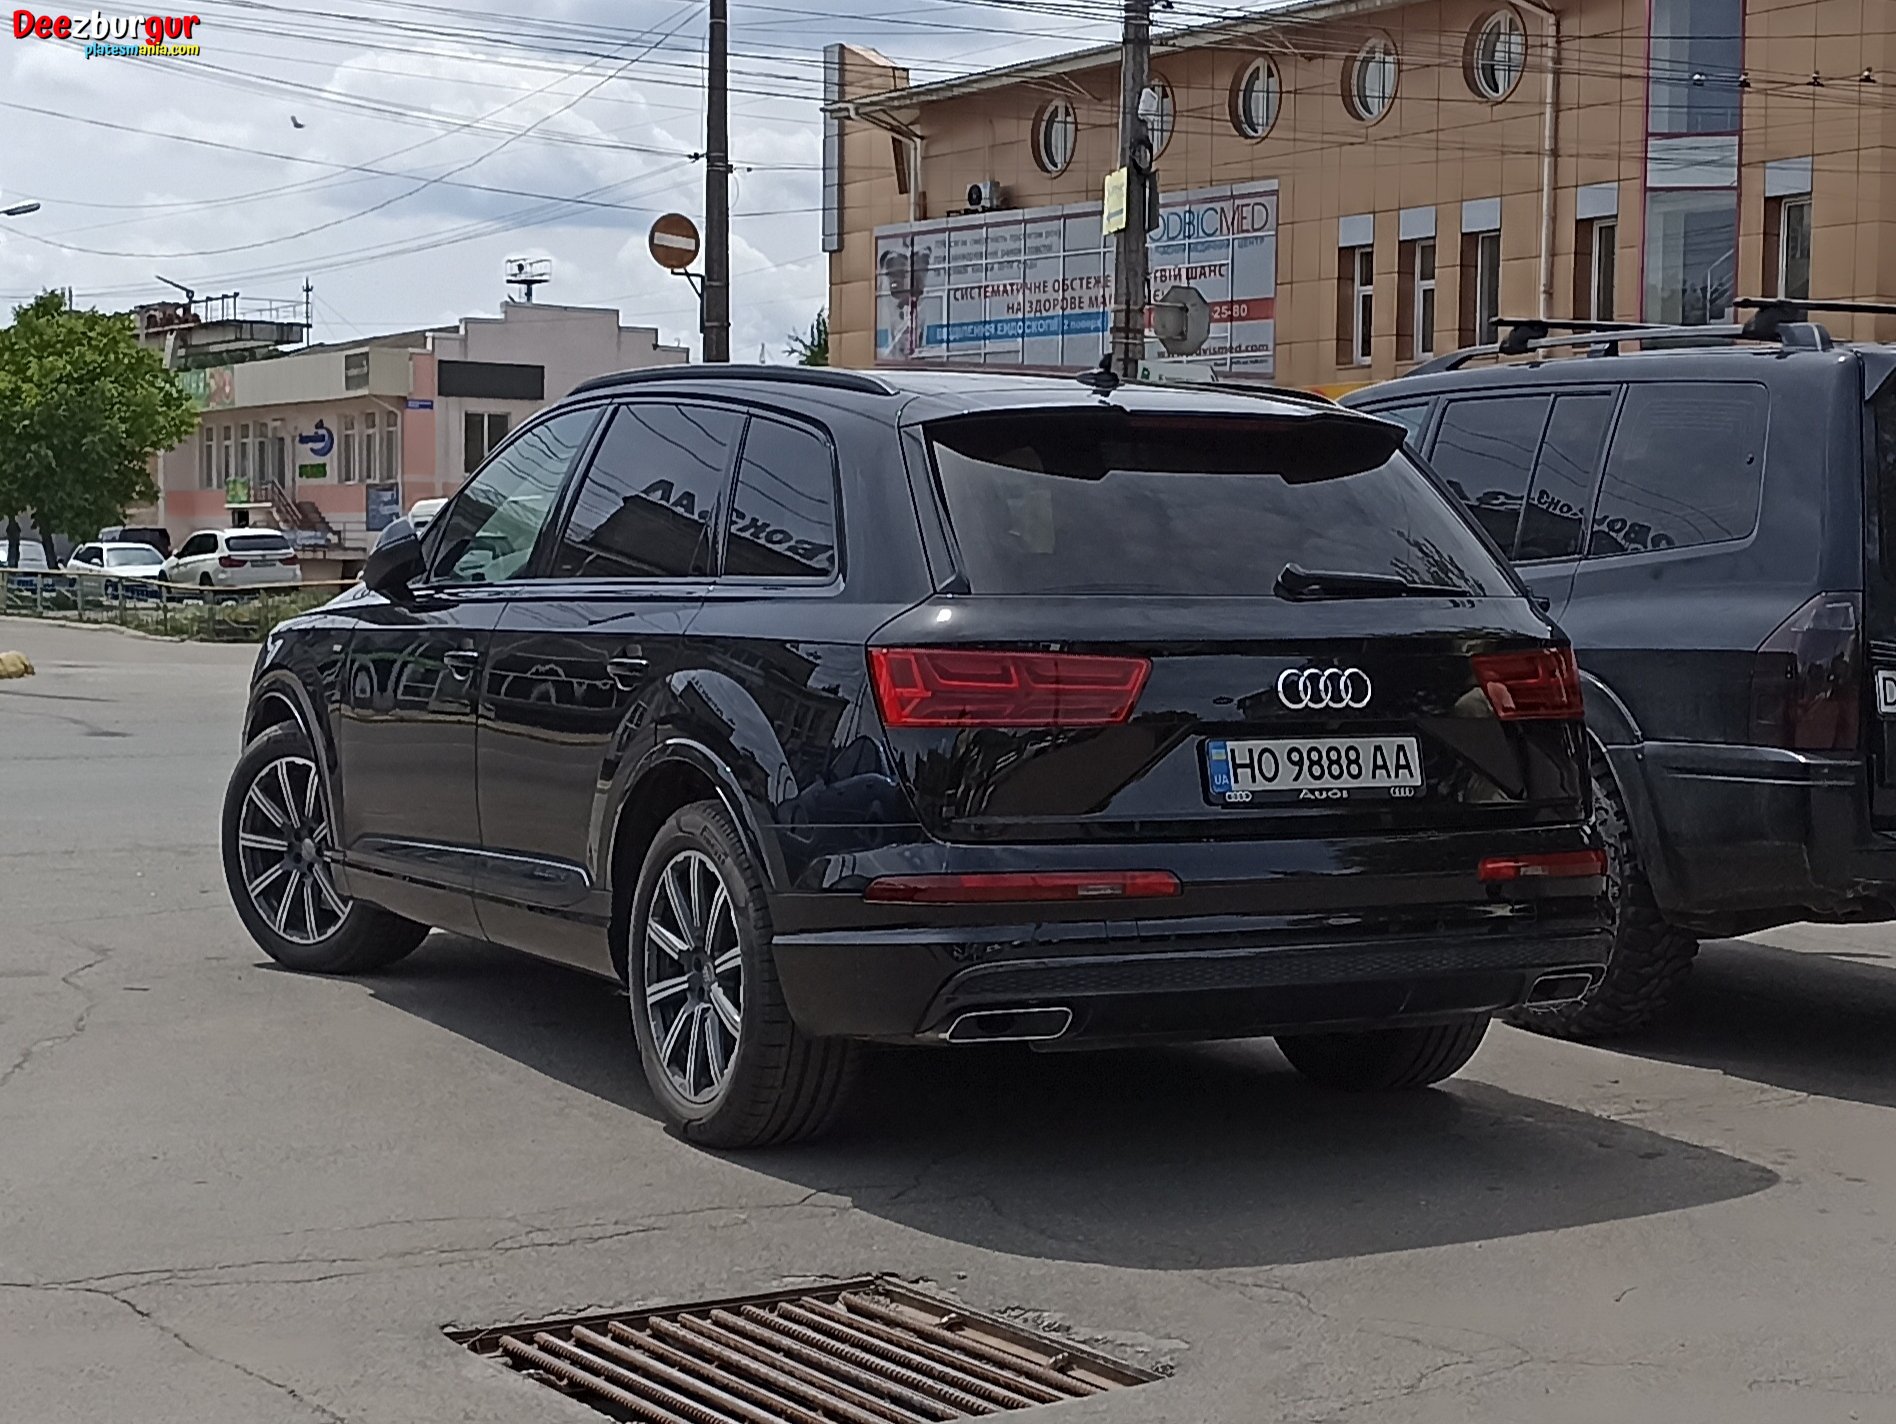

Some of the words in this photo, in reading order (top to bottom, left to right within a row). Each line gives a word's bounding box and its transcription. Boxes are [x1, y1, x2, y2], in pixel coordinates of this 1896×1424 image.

[1052, 274, 1112, 293] ОБСТЕЖЕ
[1230, 748, 1280, 784] HO
[1286, 745, 1363, 782] 9888
[1371, 744, 1414, 780] AA
[1213, 774, 1229, 786] UA
